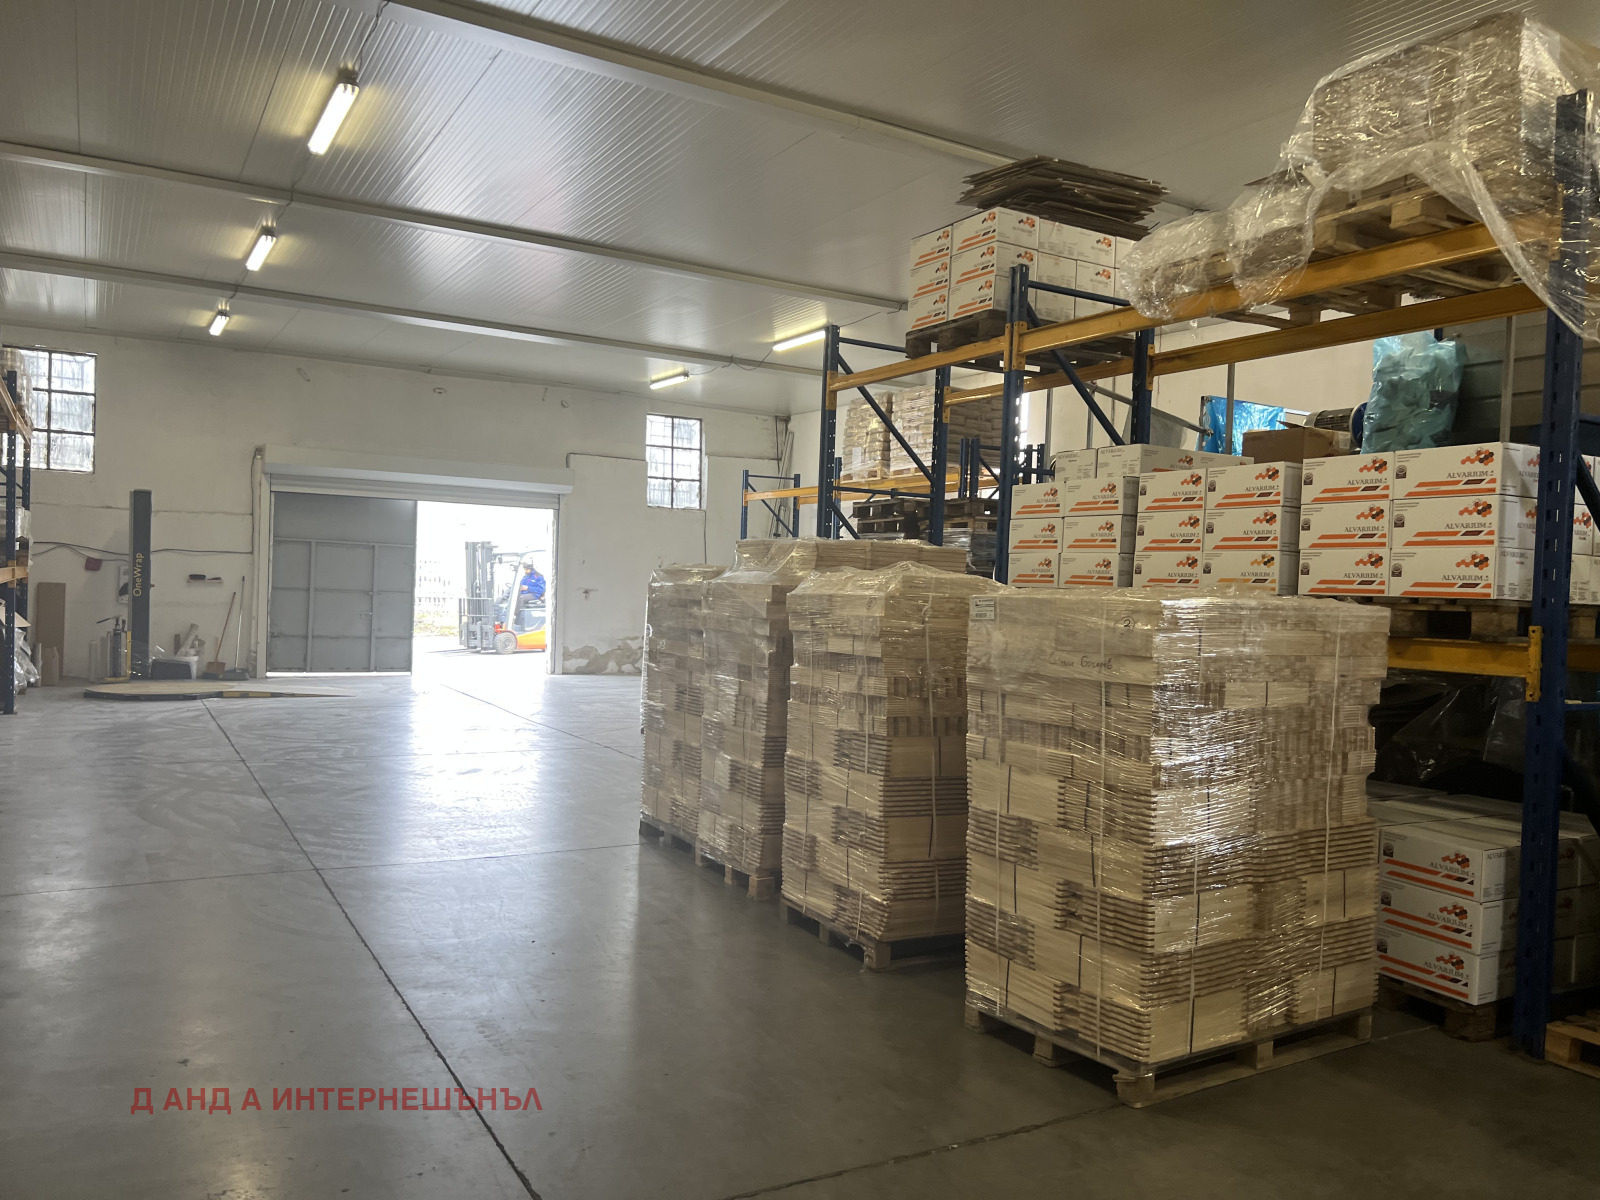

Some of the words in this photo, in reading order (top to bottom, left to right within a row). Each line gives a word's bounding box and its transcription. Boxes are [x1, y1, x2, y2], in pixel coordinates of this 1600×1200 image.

[132, 553, 144, 597] OneWrap
[1123, 618, 1131, 628] 2
[1429, 861, 1470, 876] ALVARIUM
[1426, 912, 1468, 928] ALVARIUM
[1423, 961, 1464, 978] ALVARIUM
